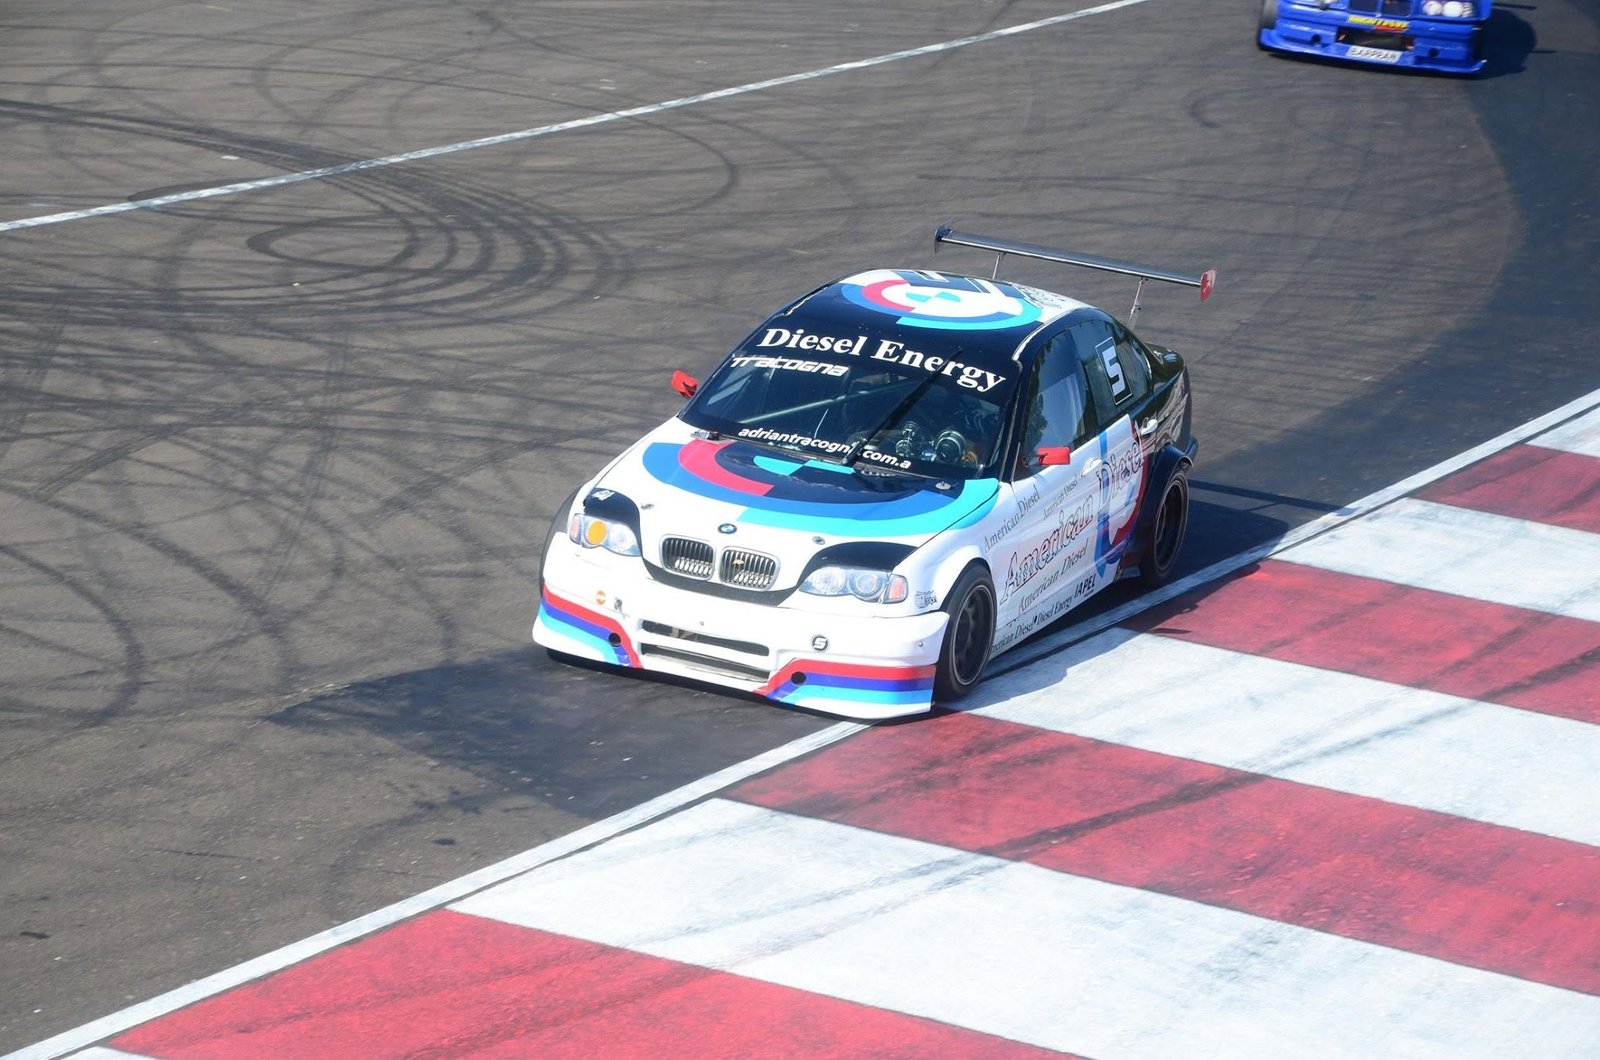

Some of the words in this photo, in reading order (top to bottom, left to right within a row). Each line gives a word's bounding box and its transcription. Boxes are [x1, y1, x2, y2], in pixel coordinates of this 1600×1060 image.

[757, 327, 868, 357] Diesel
[870, 338, 1007, 393] Energy
[984, 514, 1020, 553] American
[1017, 484, 1041, 519] Diesel
[1019, 569, 1060, 613] American
[1061, 537, 1089, 576] Diesel
